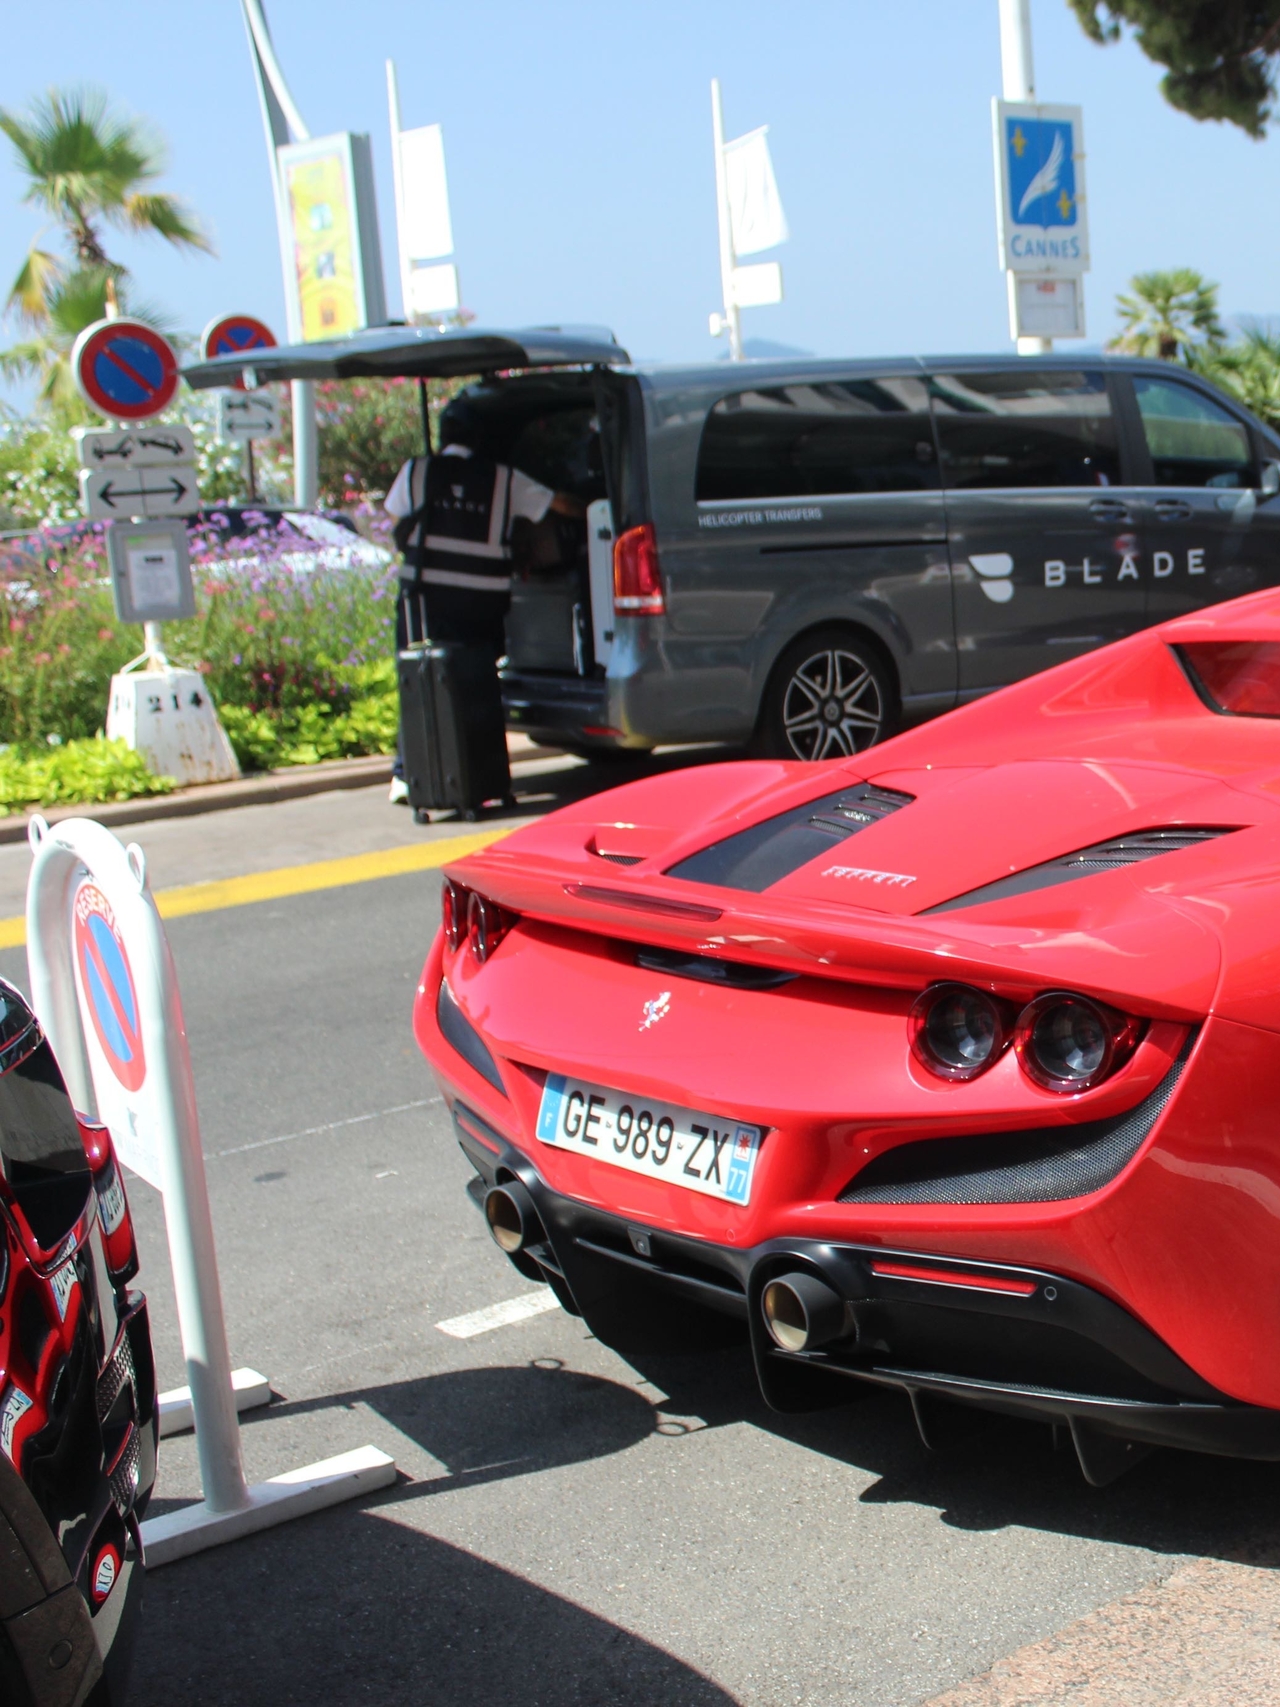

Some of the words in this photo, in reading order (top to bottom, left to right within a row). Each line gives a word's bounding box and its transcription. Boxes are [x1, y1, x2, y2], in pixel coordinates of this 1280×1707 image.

[1011, 234, 1081, 258] CANNES
[698, 511, 762, 527] HELICOPTER
[764, 507, 822, 521] TRANSFERS
[1044, 548, 1206, 588] BLADE
[545, 1112, 554, 1128] F
[728, 1167, 748, 1194] 77
